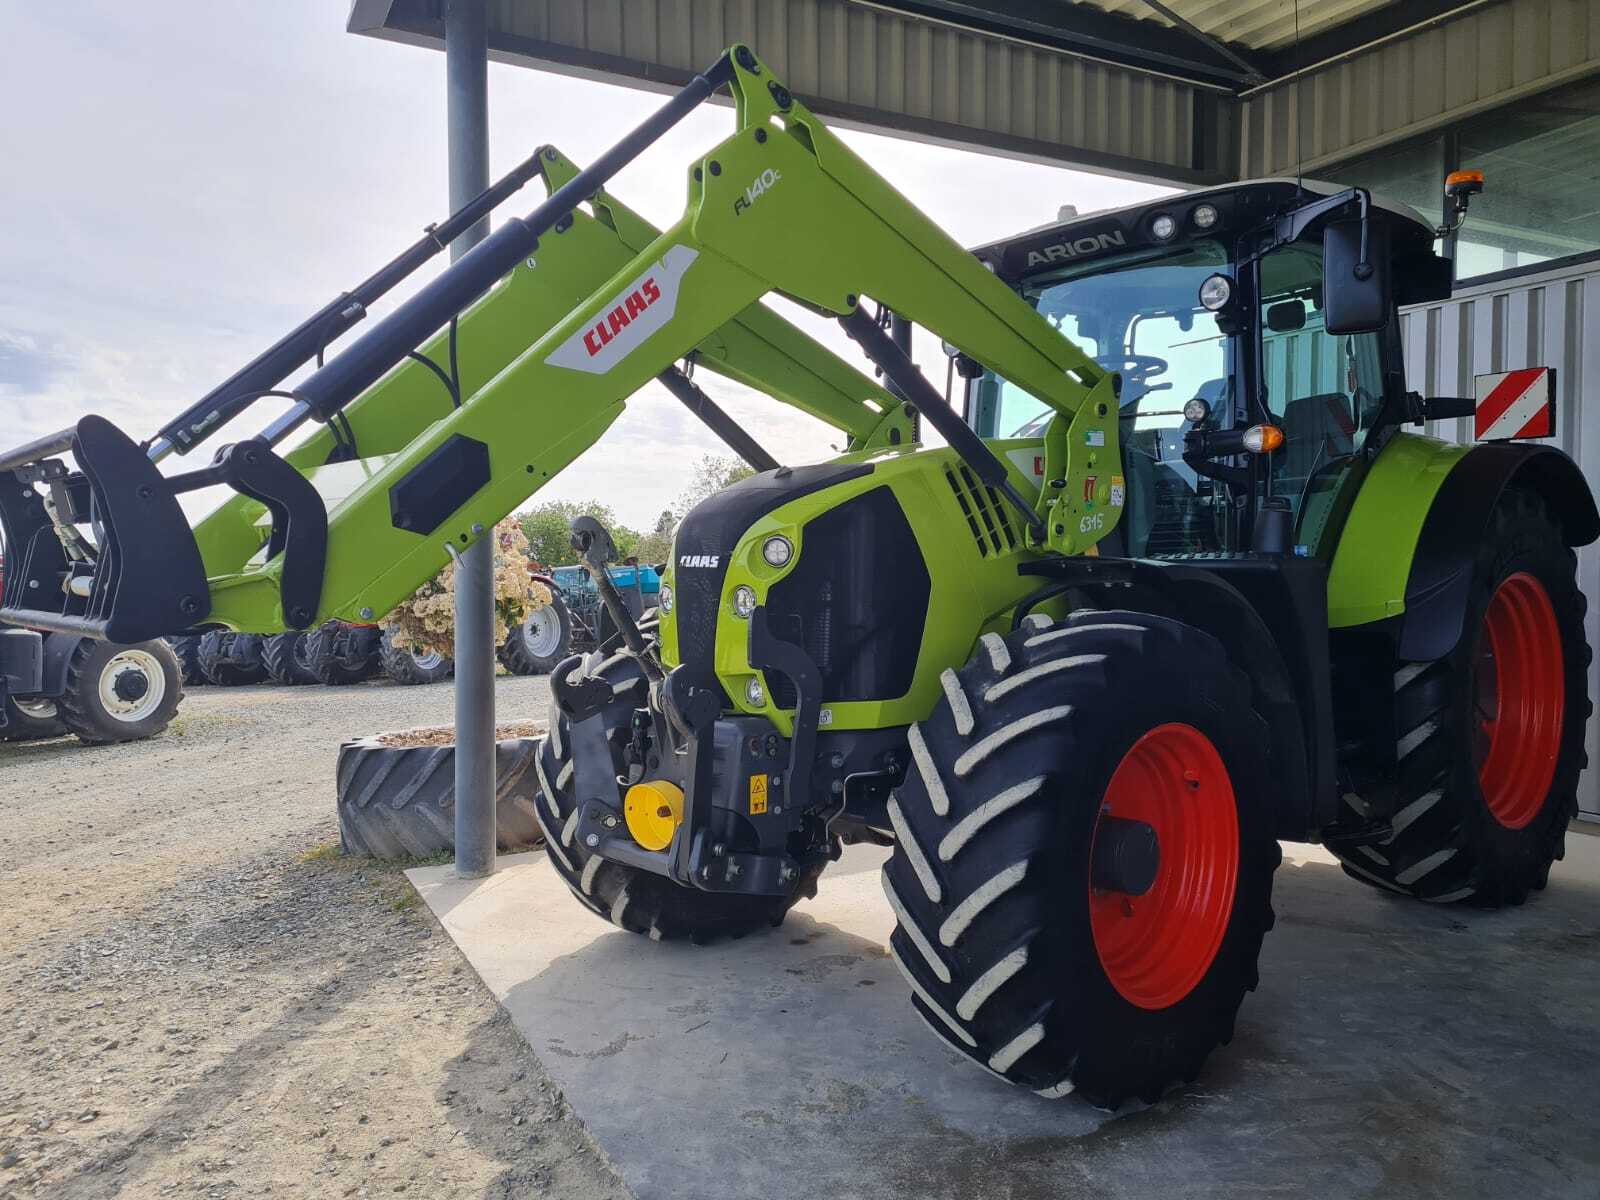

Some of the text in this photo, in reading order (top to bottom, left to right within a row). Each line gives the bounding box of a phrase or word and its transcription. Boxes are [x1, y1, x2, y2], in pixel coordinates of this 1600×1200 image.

[1028, 230, 1126, 267] ARION
[583, 277, 661, 357] CLAAS
[680, 555, 720, 568] CLAAS
